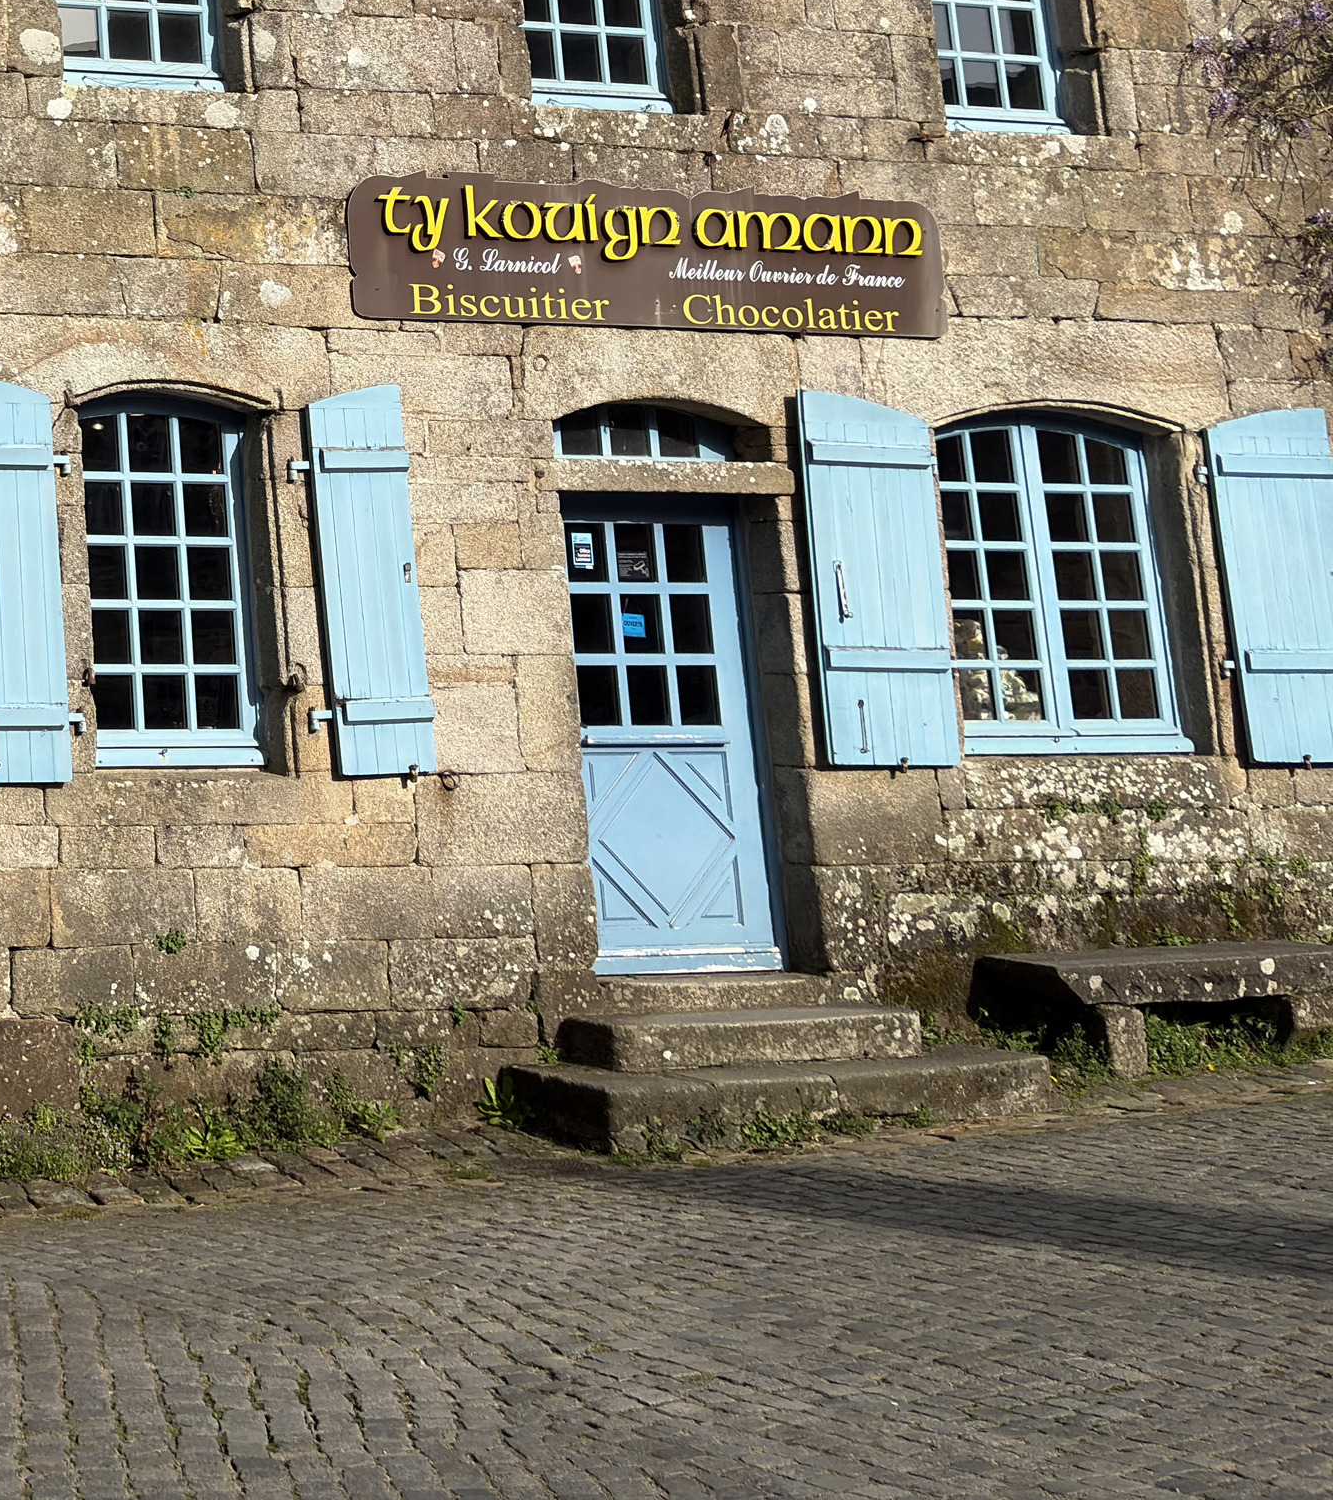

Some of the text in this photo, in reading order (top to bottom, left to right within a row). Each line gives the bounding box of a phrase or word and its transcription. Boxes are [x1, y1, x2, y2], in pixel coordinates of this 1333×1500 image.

[378, 187, 449, 251] ty
[695, 208, 923, 256] amann
[453, 248, 562, 274] G. Larnicol
[669, 257, 906, 288] Meilleur Ouvrier de France
[408, 283, 611, 321] Biscuitier
[683, 294, 899, 332] Chocolatier
